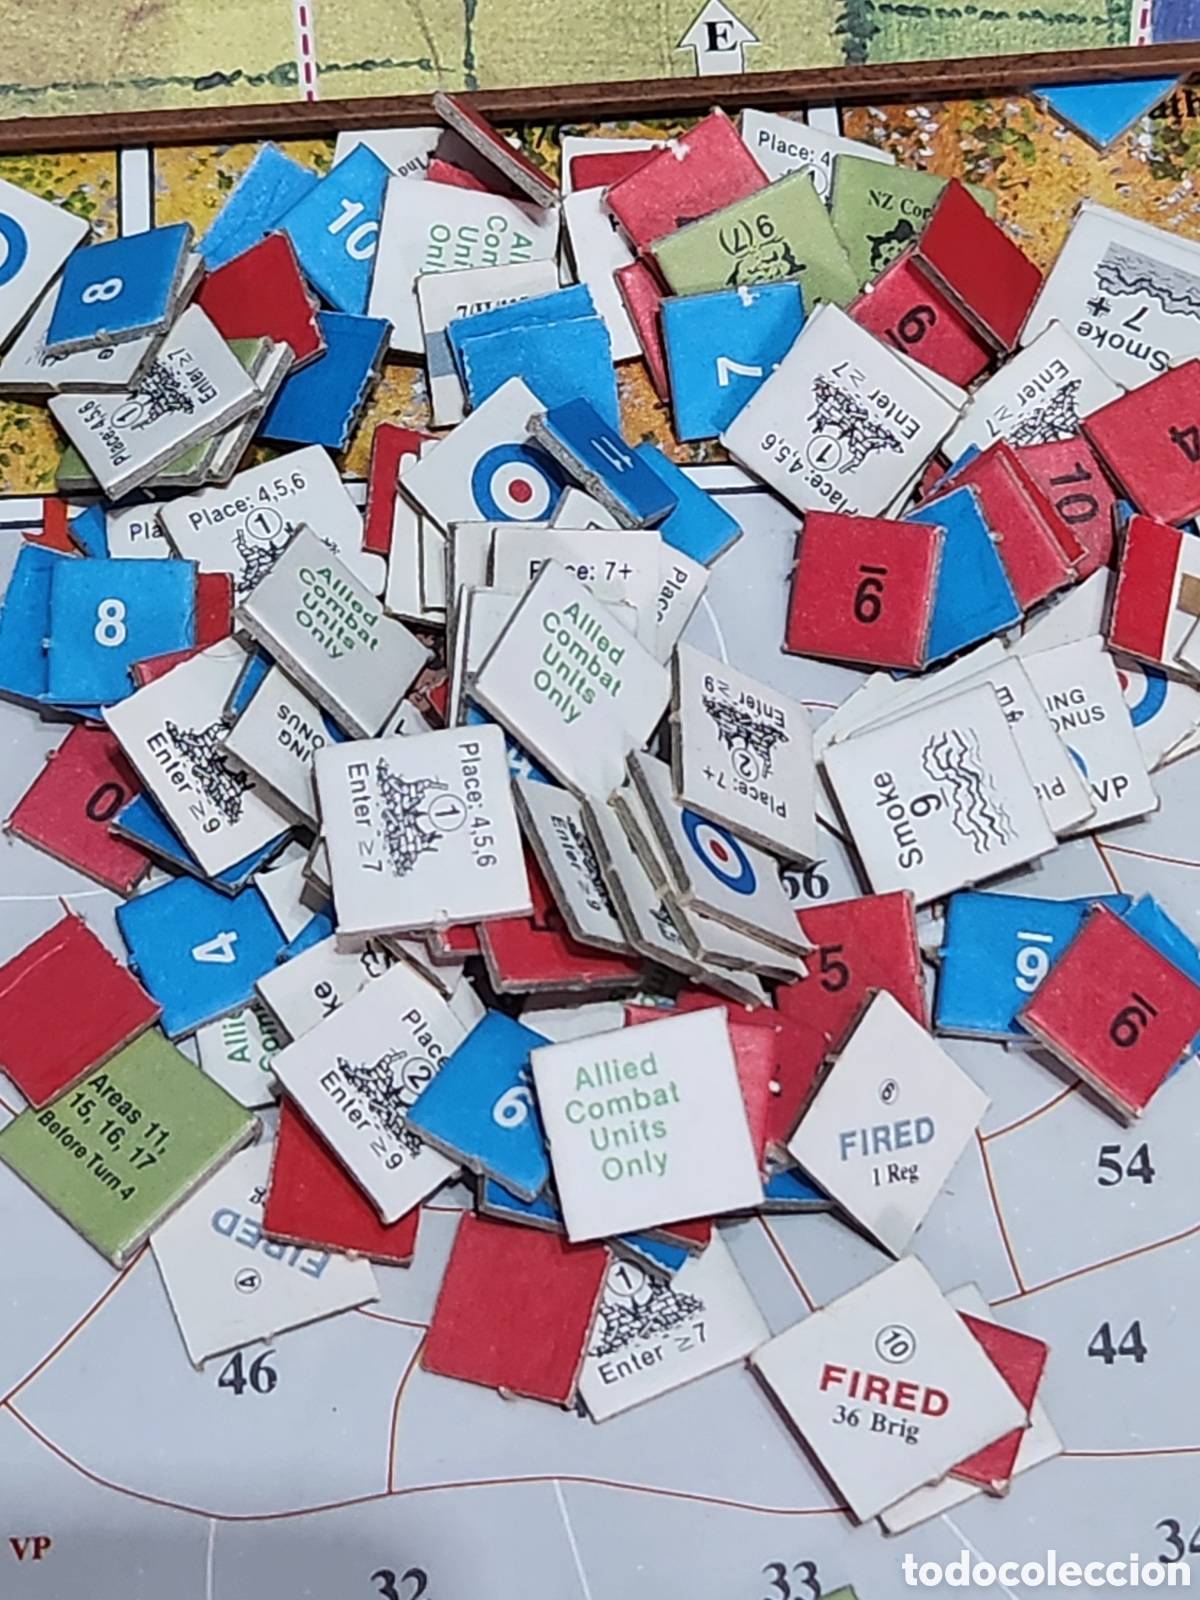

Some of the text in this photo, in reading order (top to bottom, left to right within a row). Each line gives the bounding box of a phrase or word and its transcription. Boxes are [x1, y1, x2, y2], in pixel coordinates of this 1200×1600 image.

[703, 20, 739, 52] E
[757, 130, 815, 163] Place:
[868, 189, 894, 211] NZ
[328, 199, 379, 261] 10
[82, 278, 123, 304] 8
[1077, 321, 1170, 373] Smoke
[185, 363, 218, 405] Enter
[717, 356, 763, 386] 7
[1016, 359, 1070, 406] Enter
[867, 389, 921, 440] Enter
[760, 433, 804, 475] 4,5,6
[188, 472, 306, 531] Place: 4,5,6
[1050, 462, 1099, 524] 10
[604, 560, 633, 581] 7+
[298, 568, 379, 651] Combat
[316, 566, 379, 627] Allied
[94, 599, 127, 648] 8
[296, 610, 344, 660] Only
[302, 592, 356, 650] Units
[563, 601, 625, 665] Allied
[543, 611, 622, 697] Combat
[543, 643, 596, 704] Units
[533, 670, 582, 725] Only
[740, 691, 785, 729] Enter
[1045, 688, 1085, 713] ING
[146, 731, 194, 793] Enter
[347, 762, 372, 828] Enter
[458, 741, 497, 868] Place: 4,5,6
[733, 779, 788, 819] Place:
[550, 814, 581, 872] Enter
[873, 771, 924, 869] Smoke
[191, 931, 238, 964] 4
[819, 945, 849, 992] 5
[574, 1052, 658, 1092] Allied
[87, 1073, 171, 1156] Areas 11,
[319, 1070, 372, 1131] Enter
[564, 1081, 680, 1125] Combat
[68, 1092, 157, 1170] 15, 16, 17
[590, 1117, 667, 1152] Units
[838, 1115, 935, 1162] FIRED
[36, 1109, 136, 1202] Before Turn 4
[601, 1150, 668, 1182] Only
[887, 1162, 920, 1185] Reg
[1097, 1142, 1156, 1187] 54
[597, 1343, 664, 1385] Enter
[1087, 1320, 1148, 1365] 44
[217, 1350, 278, 1396] 46
[818, 1362, 949, 1419] FIRED
[832, 1403, 920, 1446] 36 Brig
[9, 1536, 52, 1561] VP
[762, 1561, 822, 1600] 33
